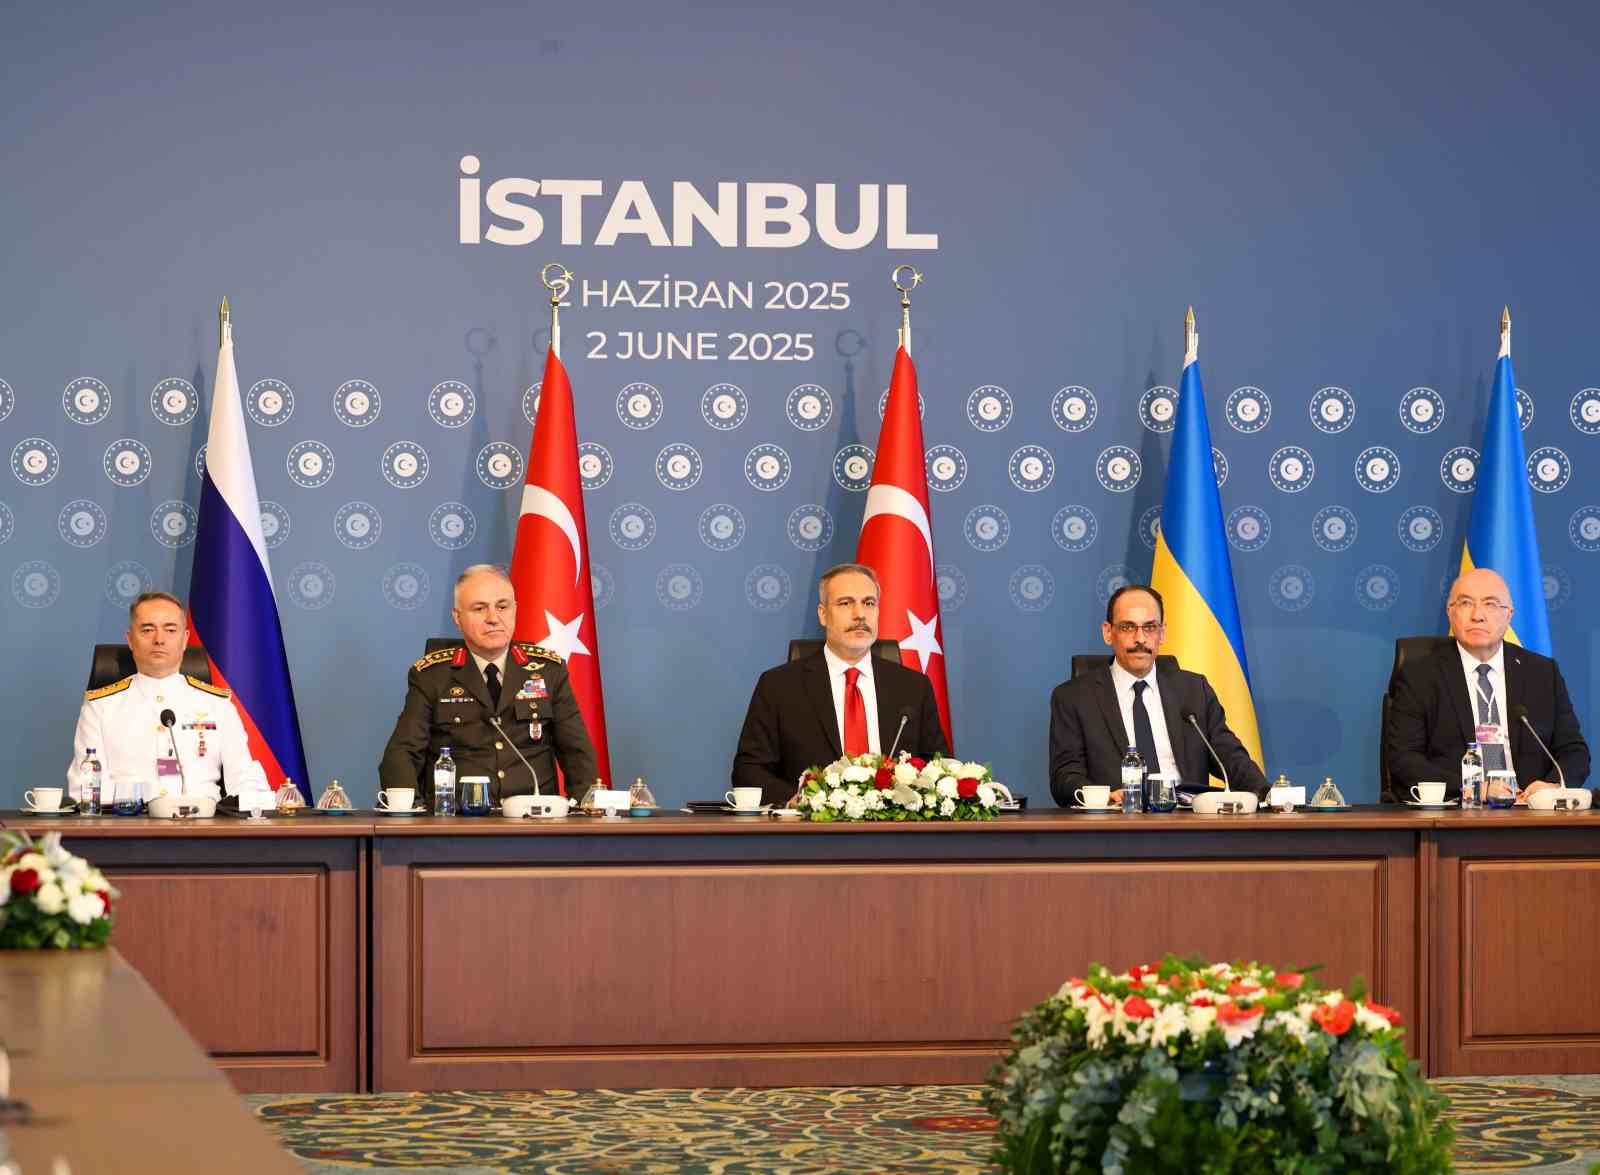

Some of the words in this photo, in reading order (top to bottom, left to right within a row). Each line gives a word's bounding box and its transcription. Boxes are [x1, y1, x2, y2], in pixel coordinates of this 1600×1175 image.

[459, 155, 938, 249] İSTANBUL
[550, 279, 571, 307] 2
[582, 274, 752, 308] HAZİRAN
[764, 281, 851, 309] 2025
[586, 331, 608, 359] 2
[615, 331, 719, 359] JUNE
[727, 332, 815, 360] 2025
